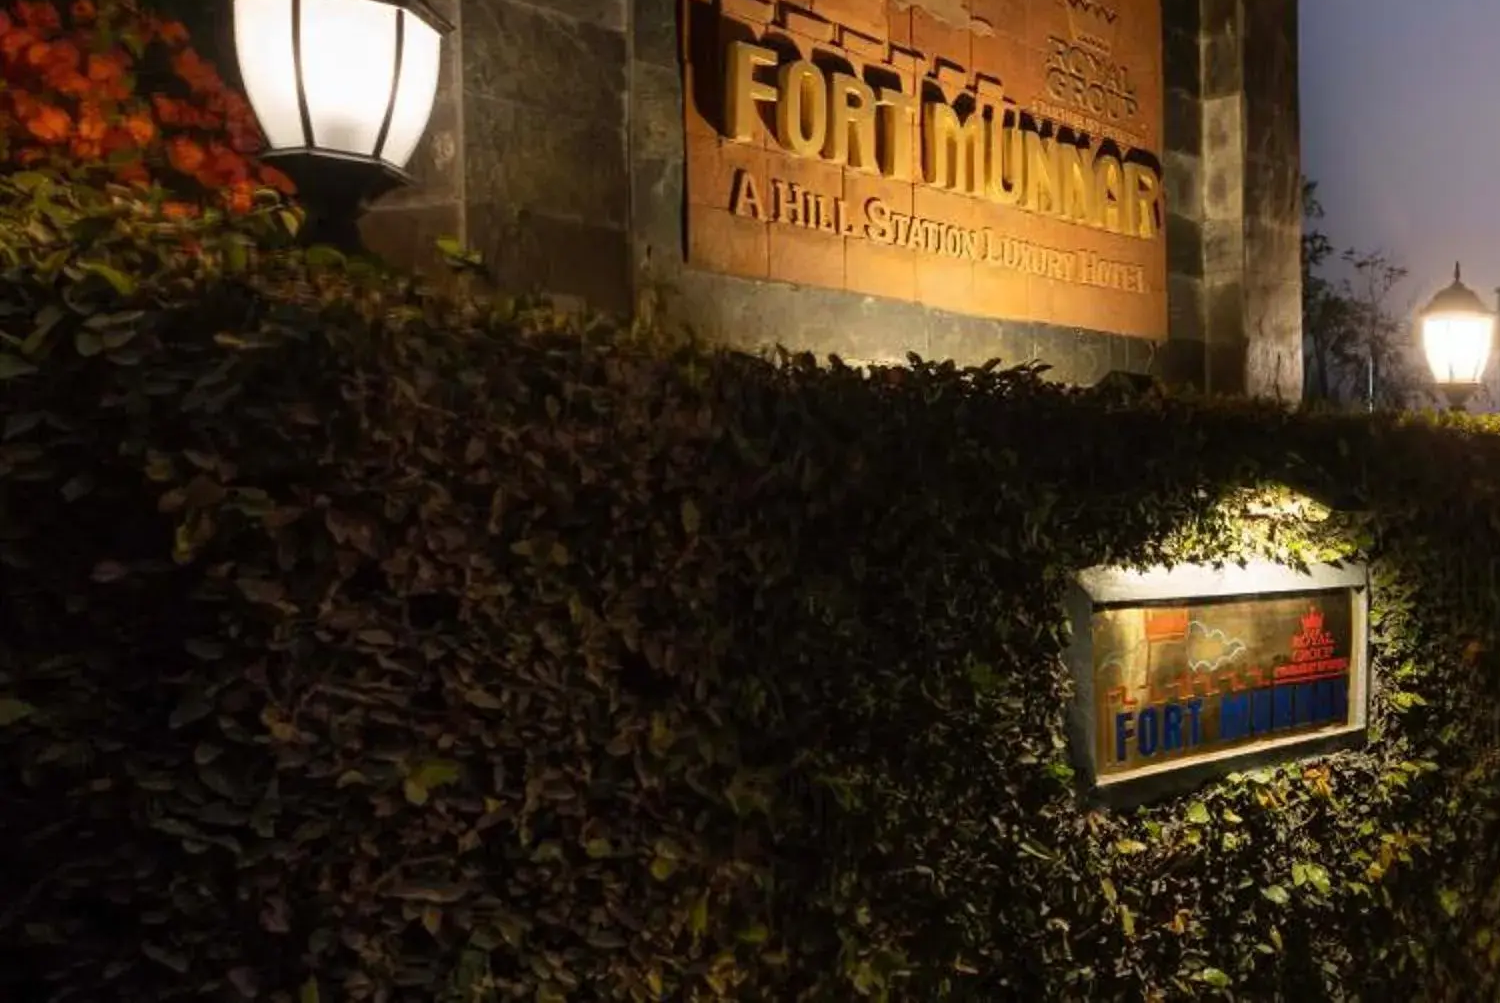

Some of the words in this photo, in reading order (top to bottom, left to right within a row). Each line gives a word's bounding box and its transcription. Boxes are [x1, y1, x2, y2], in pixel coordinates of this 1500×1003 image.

[1045, 67, 1140, 119] GROUP
[727, 40, 922, 185] FORT
[925, 93, 1160, 240] MUNNAR
[733, 170, 768, 224] A
[1115, 698, 1204, 762] FORT
